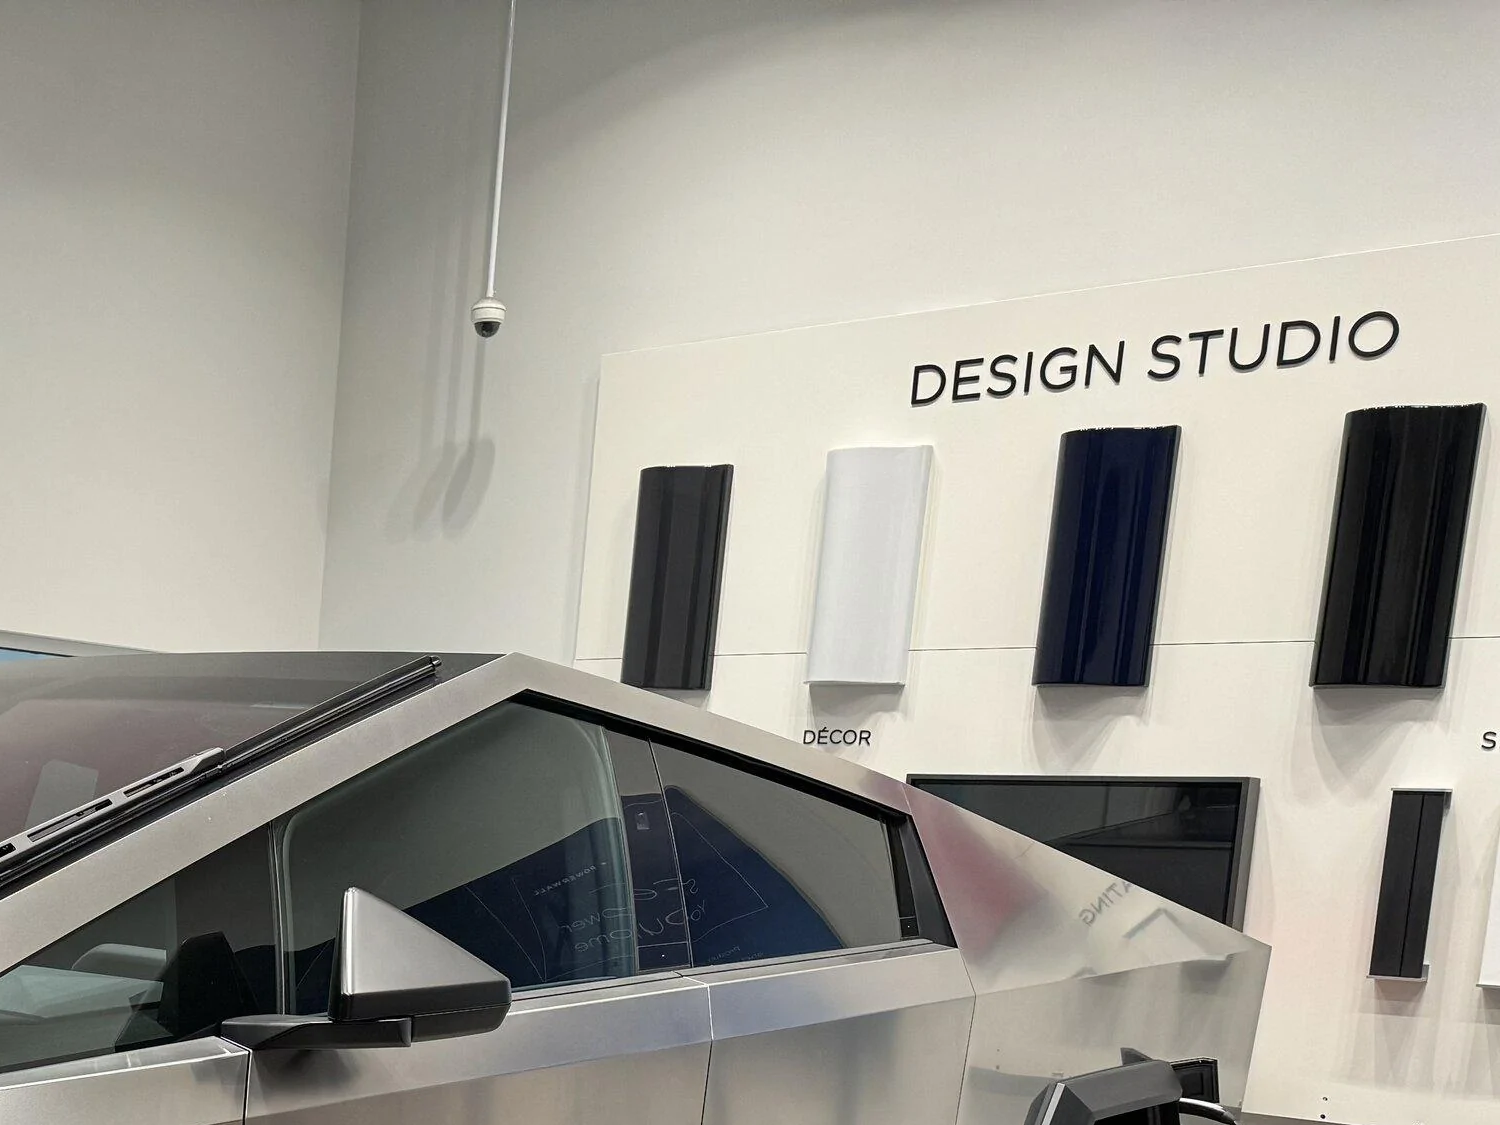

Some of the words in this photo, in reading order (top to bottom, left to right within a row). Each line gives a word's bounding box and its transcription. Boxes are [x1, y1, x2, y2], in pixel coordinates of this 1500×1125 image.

[910, 340, 1126, 407] DESIGN
[1147, 310, 1400, 381] STUDIO
[802, 726, 872, 746] DÉCOR
[1481, 731, 1500, 751] S
